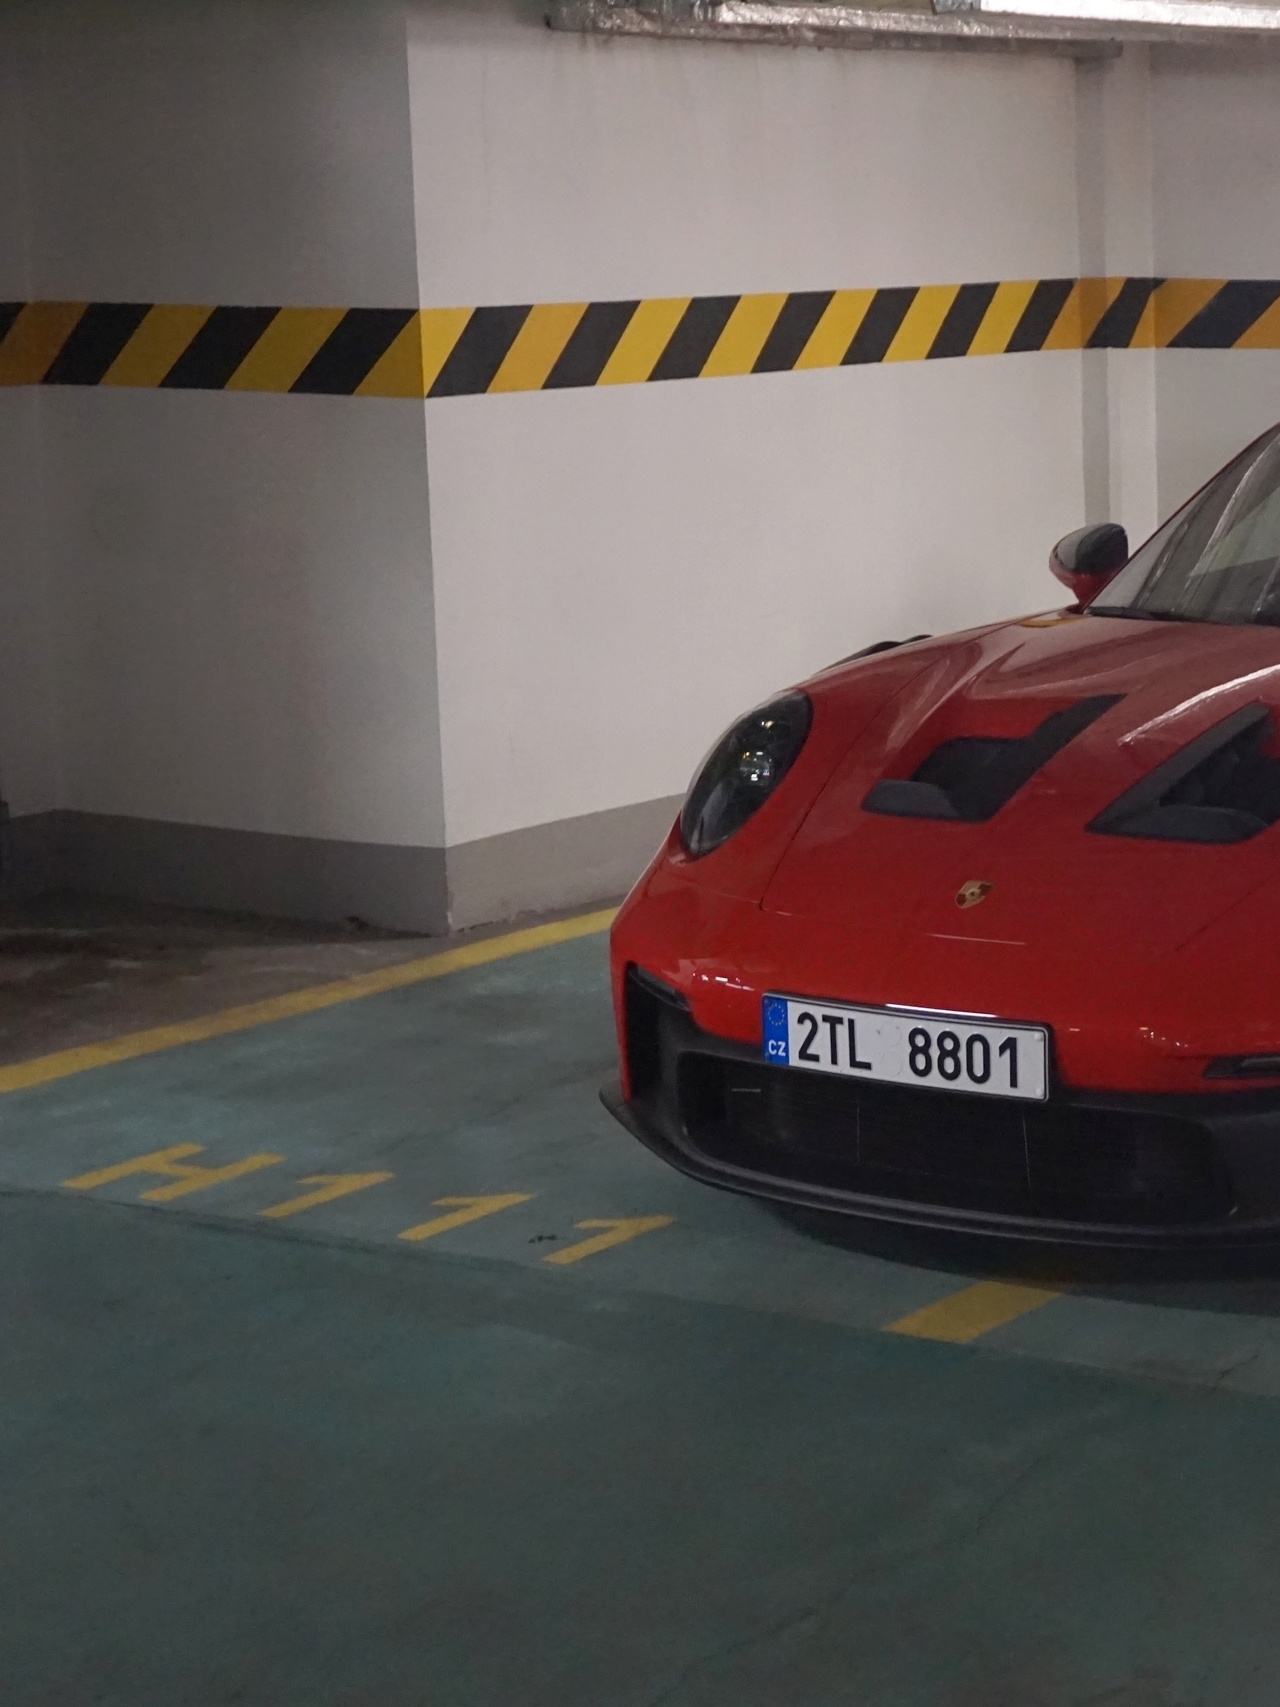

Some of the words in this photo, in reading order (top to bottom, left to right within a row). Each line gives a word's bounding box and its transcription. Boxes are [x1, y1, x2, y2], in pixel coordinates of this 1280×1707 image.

[768, 1039, 786, 1057] CZ
[797, 1011, 872, 1071] 2TL
[908, 1027, 1018, 1088] 8801
